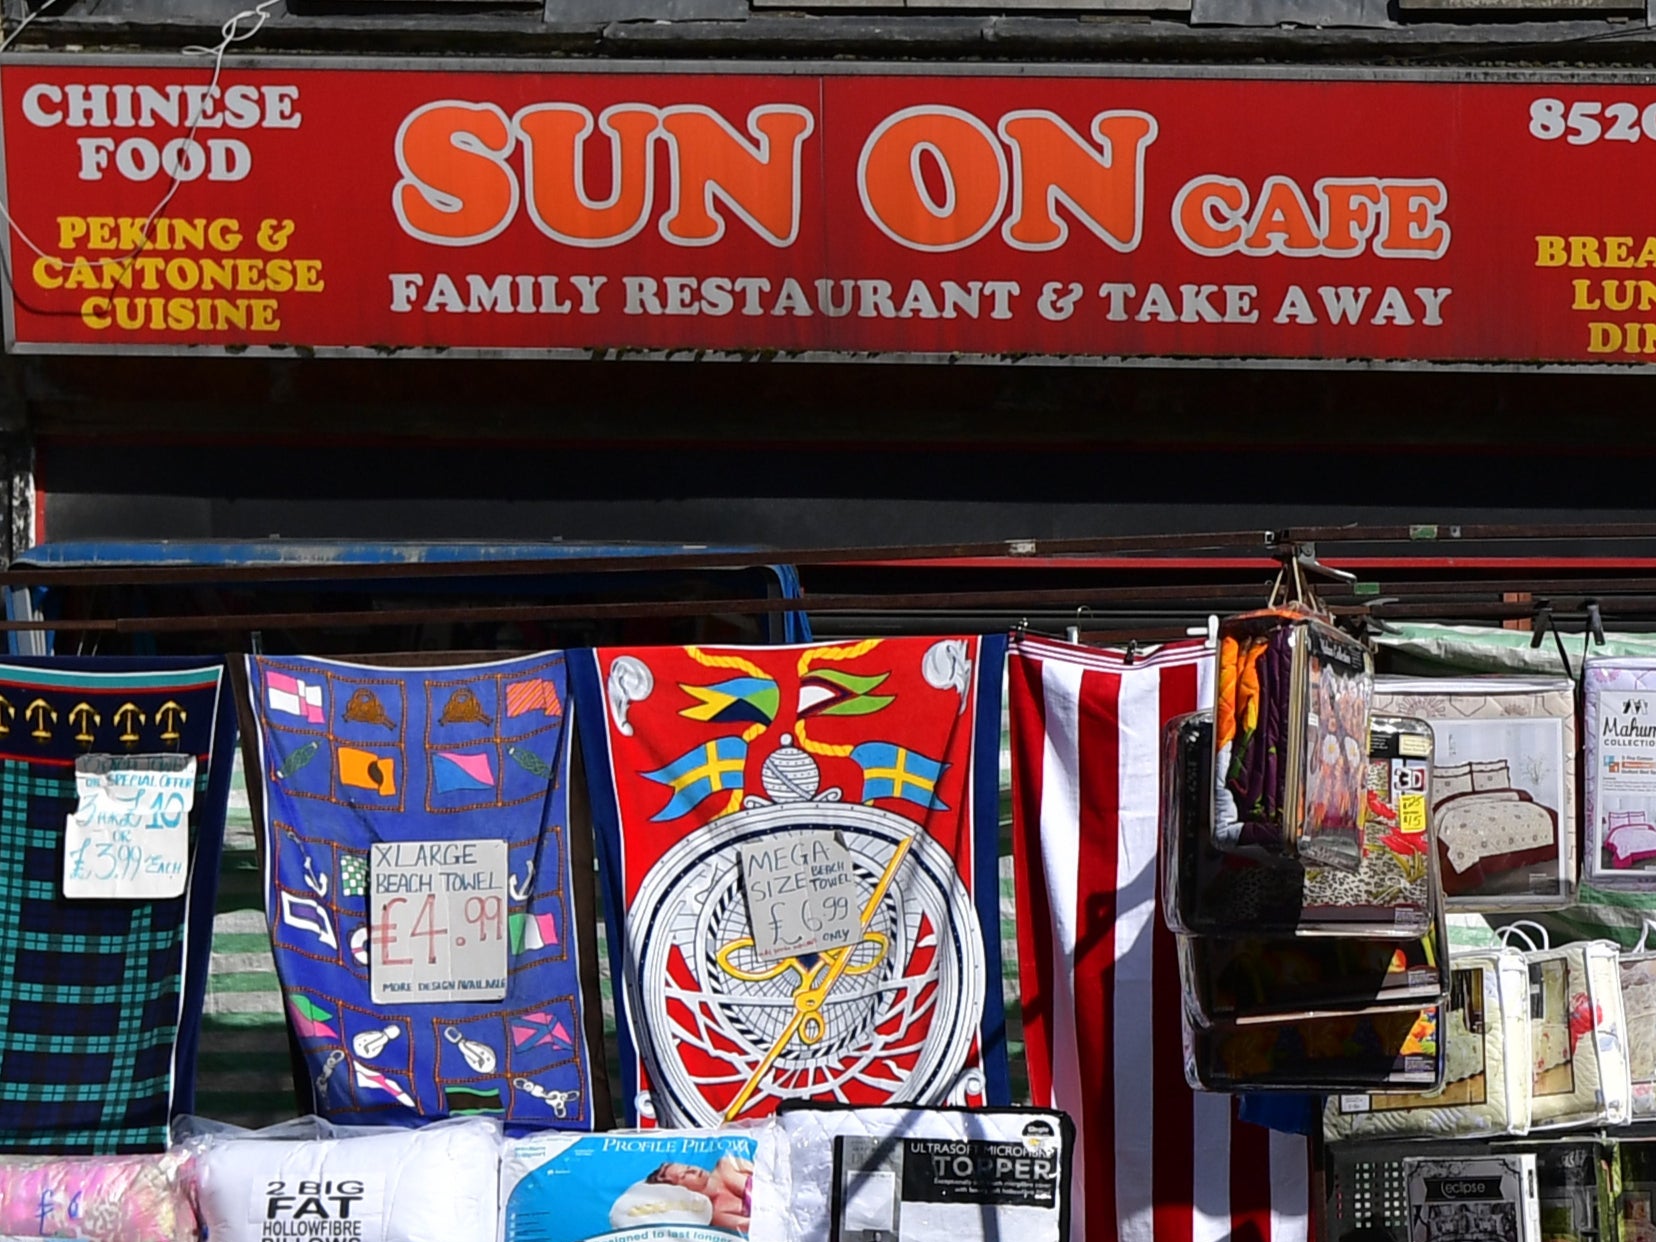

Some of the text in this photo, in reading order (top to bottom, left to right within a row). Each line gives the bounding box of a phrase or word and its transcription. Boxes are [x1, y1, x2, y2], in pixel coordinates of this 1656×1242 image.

[22, 84, 302, 129] CHINESE
[77, 137, 252, 183] FOOD
[392, 99, 1451, 260] SUN ON CAFE
[57, 215, 295, 251] PEKING &
[32, 256, 324, 294] CANTONESE
[389, 273, 1453, 328] FAMILY RESTAURANT & TAKE AWAY
[81, 297, 280, 333] CUISINE
[106, 773, 156, 788] SPECIAL
[160, 774, 193, 788] OFFER
[1394, 768, 1425, 790] 3D
[69, 838, 142, 881] £3.99
[748, 840, 829, 877] MEGA
[811, 861, 845, 876] BEACH
[376, 871, 503, 894] BEACH TOWEL
[751, 872, 807, 902] SIZE
[809, 873, 852, 891] TOWEL
[371, 893, 503, 965] £4.99
[768, 895, 849, 946] £6.99
[822, 929, 850, 942] ONLY
[383, 982, 412, 992] MORE
[418, 980, 455, 991] DESIGN
[602, 1138, 677, 1153] PROFILE
[911, 1142, 977, 1155] ULTRASOFT
[933, 1155, 1052, 1180] TOPPER
[266, 1180, 364, 1195] 2 BIG
[1442, 1181, 1487, 1196] eclipse
[267, 1196, 363, 1219] FAT
[263, 1220, 362, 1236] HOLLOWFIBRE
[653, 1229, 665, 1239] to
[667, 1229, 690, 1239] last
